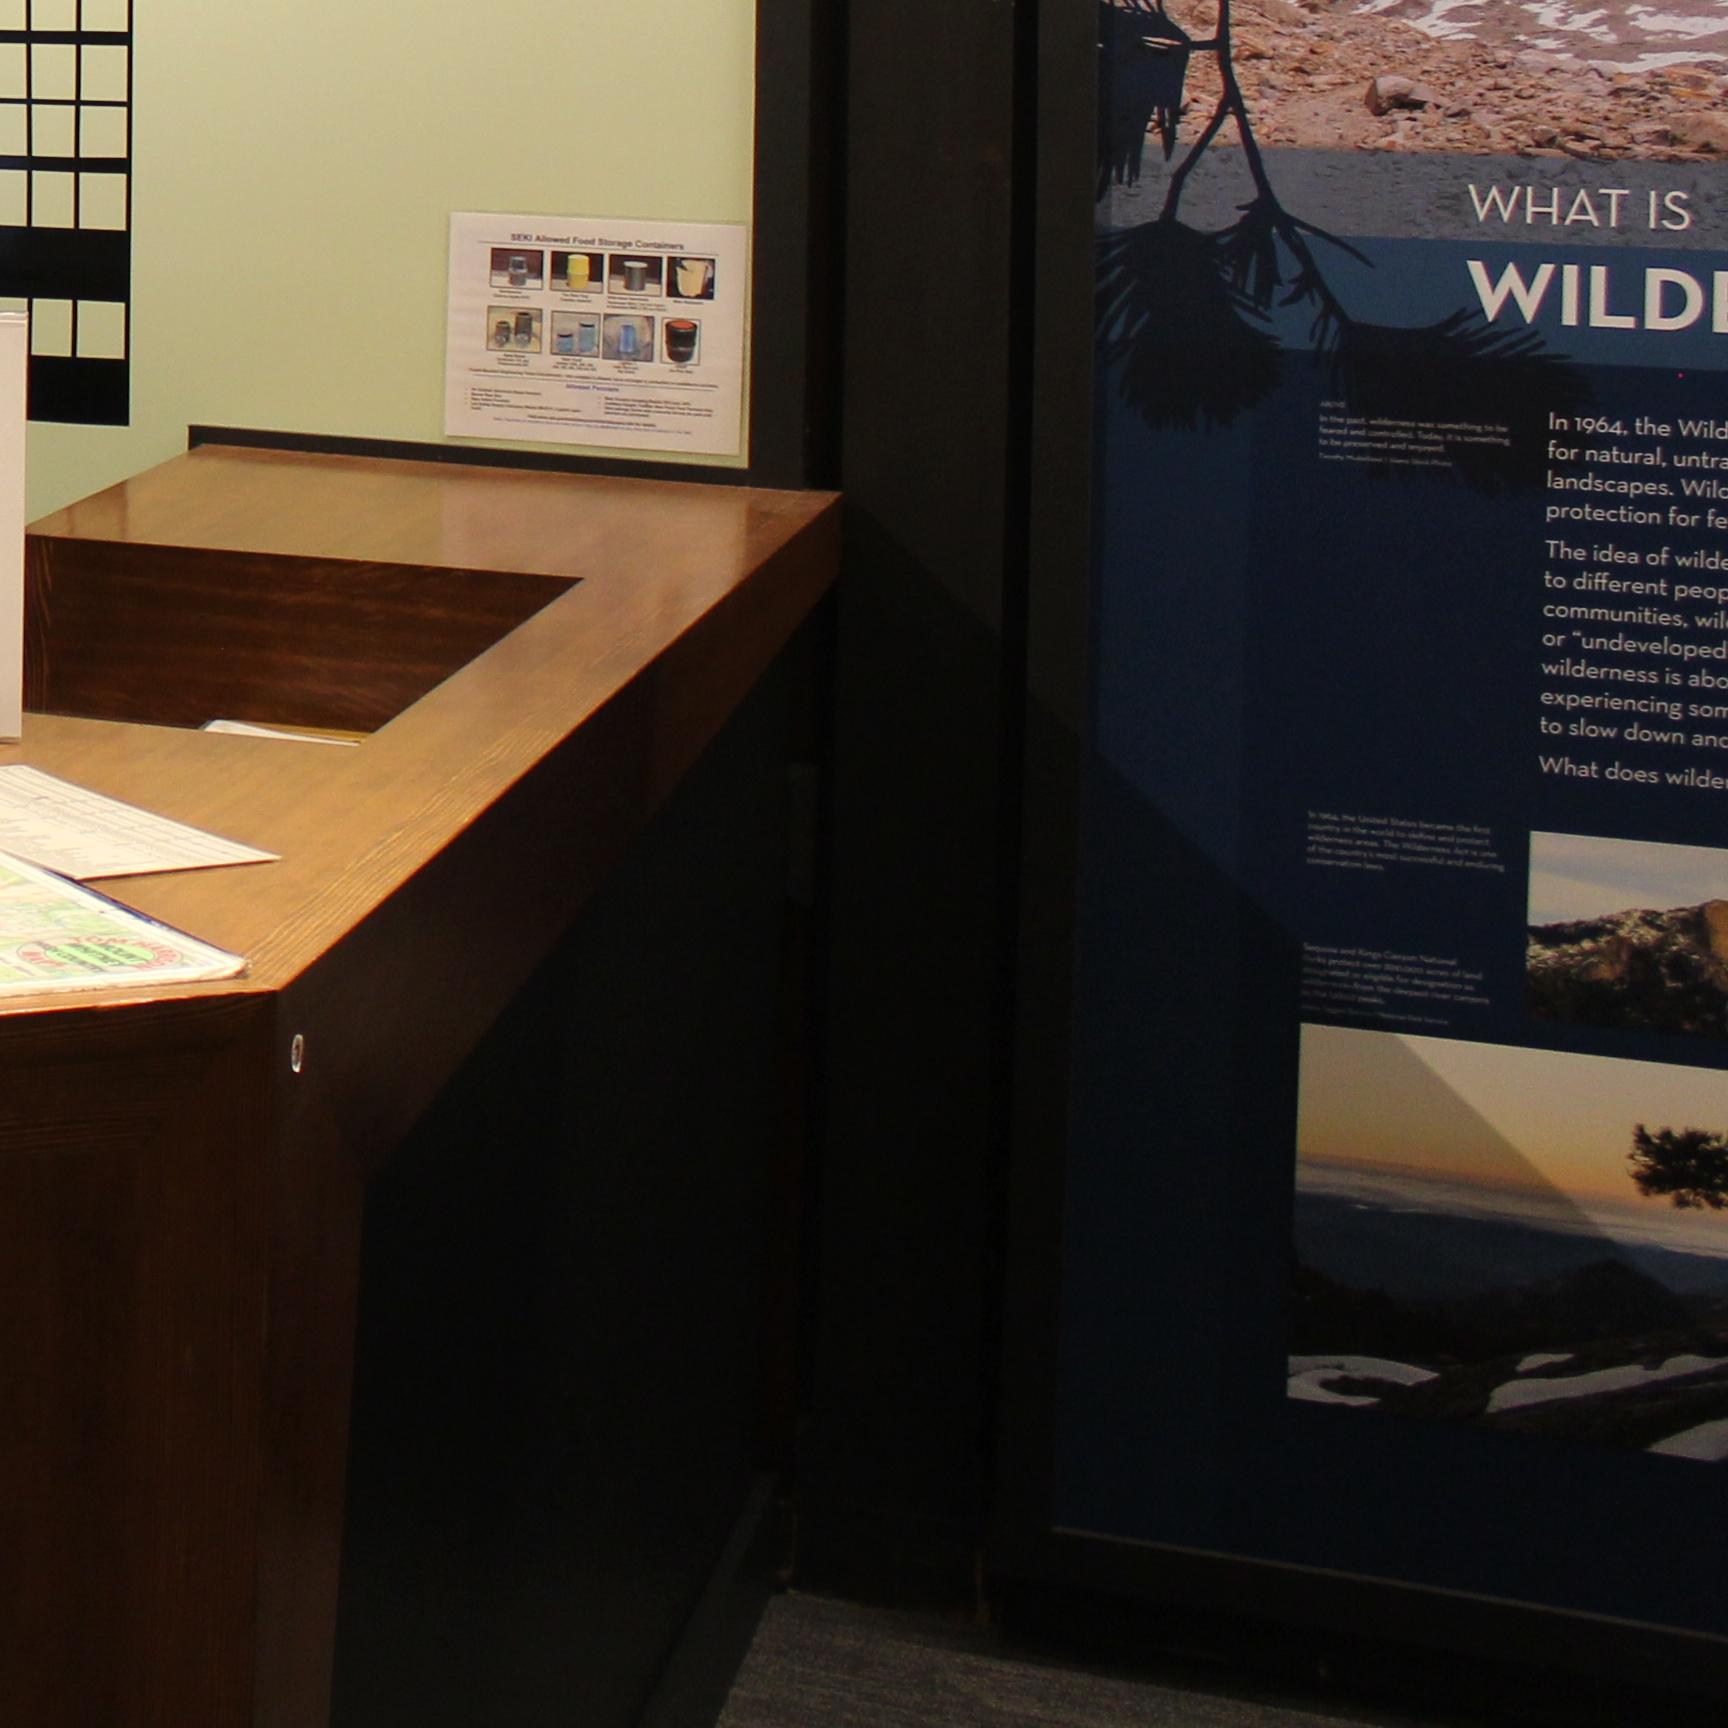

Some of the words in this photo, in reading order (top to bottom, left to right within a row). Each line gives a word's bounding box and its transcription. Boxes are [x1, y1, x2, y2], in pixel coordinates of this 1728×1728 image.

[1468, 184, 1630, 227] WHAT
[1649, 190, 1693, 231] IS
[535, 234, 571, 244] Allowed
[573, 236, 595, 246] Food
[598, 237, 633, 249] Storage
[635, 239, 684, 250] Containers
[1549, 412, 1568, 430] In
[1574, 417, 1628, 436] 1964,
[1635, 416, 1671, 436] the
[1548, 440, 1579, 460] for
[1585, 446, 1667, 467] natural,
[1547, 470, 1674, 498] landscapes.
[1546, 504, 1661, 524] protection
[1669, 506, 1701, 526] for
[1545, 540, 1587, 560] The
[1593, 544, 1639, 564] idea
[1646, 547, 1670, 565] of
[1544, 571, 1566, 589] to
[1573, 571, 1668, 596] different
[1543, 605, 1688, 627] communities,
[1695, 611, 1728, 629] wil
[1543, 633, 1566, 646] or
[1541, 658, 1659, 684] wilderness
[1665, 668, 1682, 686] is
[1540, 692, 1683, 720] experiencing
[1540, 717, 1562, 734] to
[1568, 718, 1618, 737] slow
[1624, 722, 1684, 744] down
[1538, 756, 1599, 778] What
[1605, 761, 1660, 783] does
